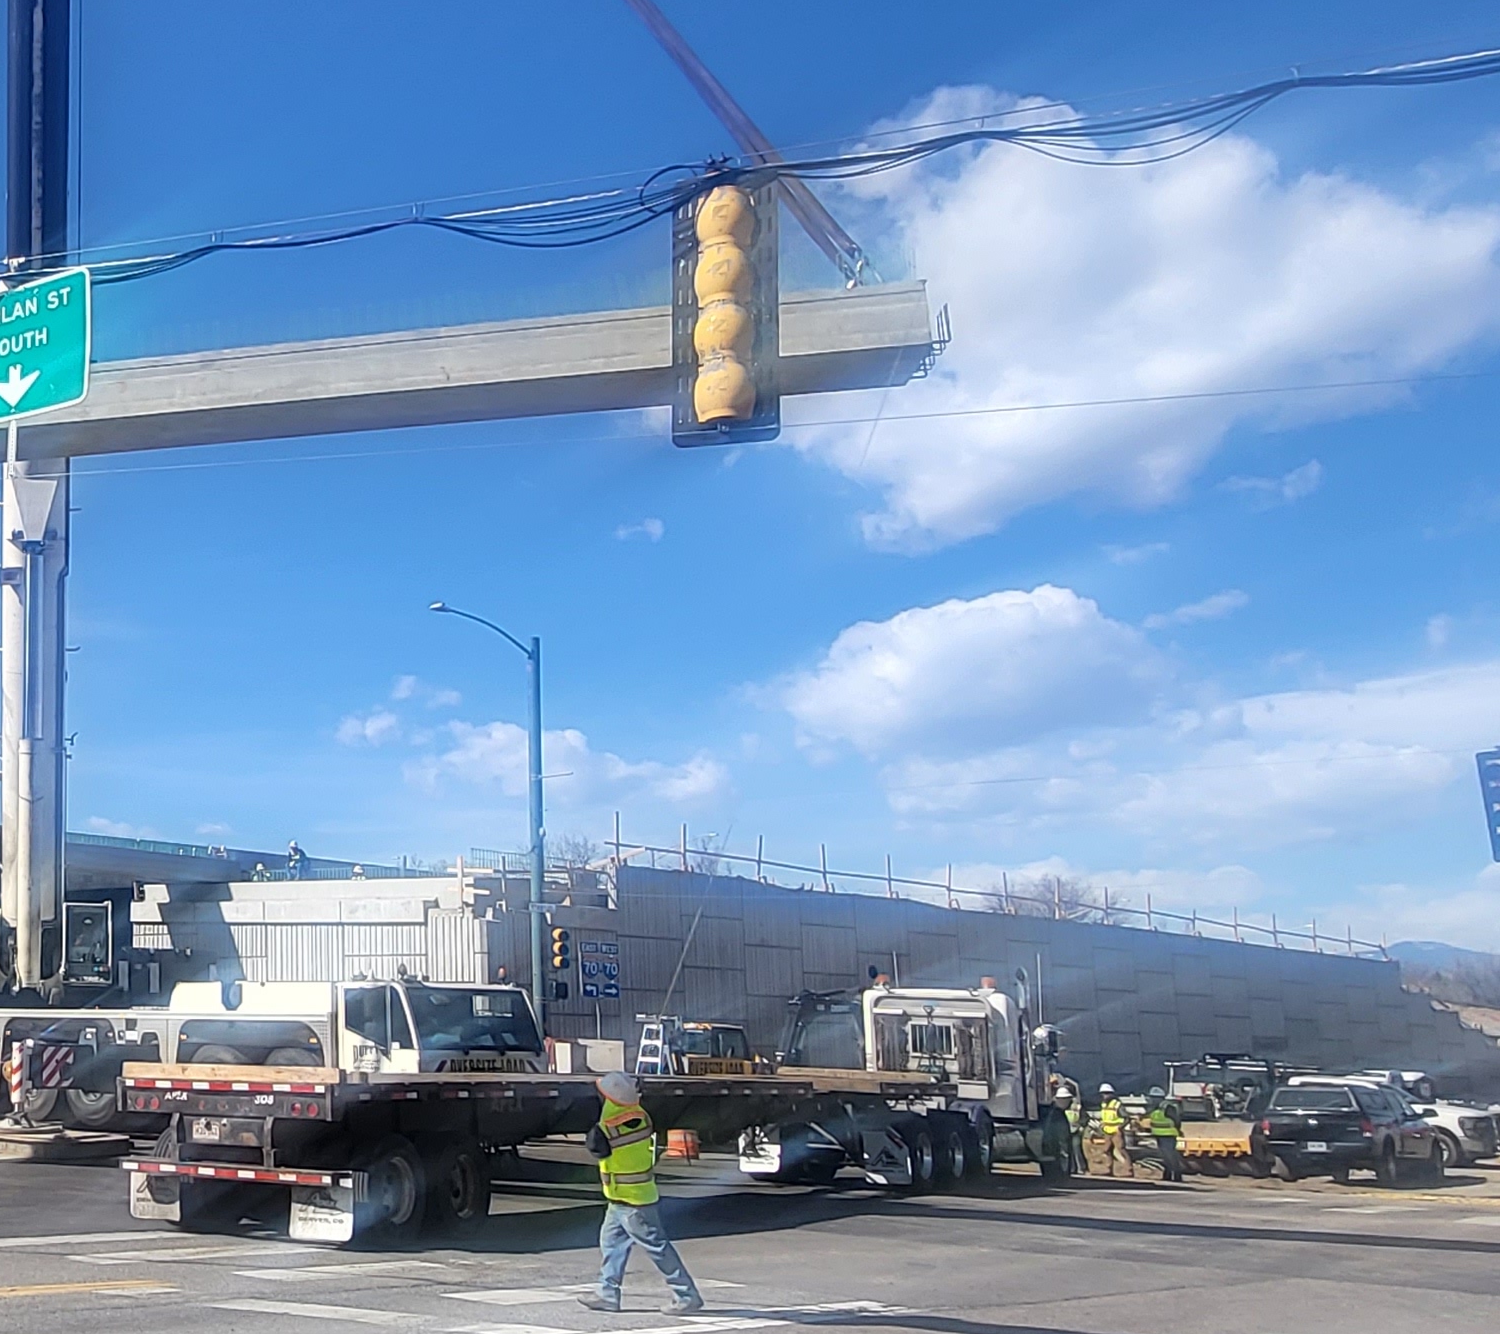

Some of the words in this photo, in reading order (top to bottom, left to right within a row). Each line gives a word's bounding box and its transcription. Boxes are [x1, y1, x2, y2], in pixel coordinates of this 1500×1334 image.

[47, 287, 71, 309] ST
[583, 961, 598, 975] 70
[604, 962, 619, 975] 70
